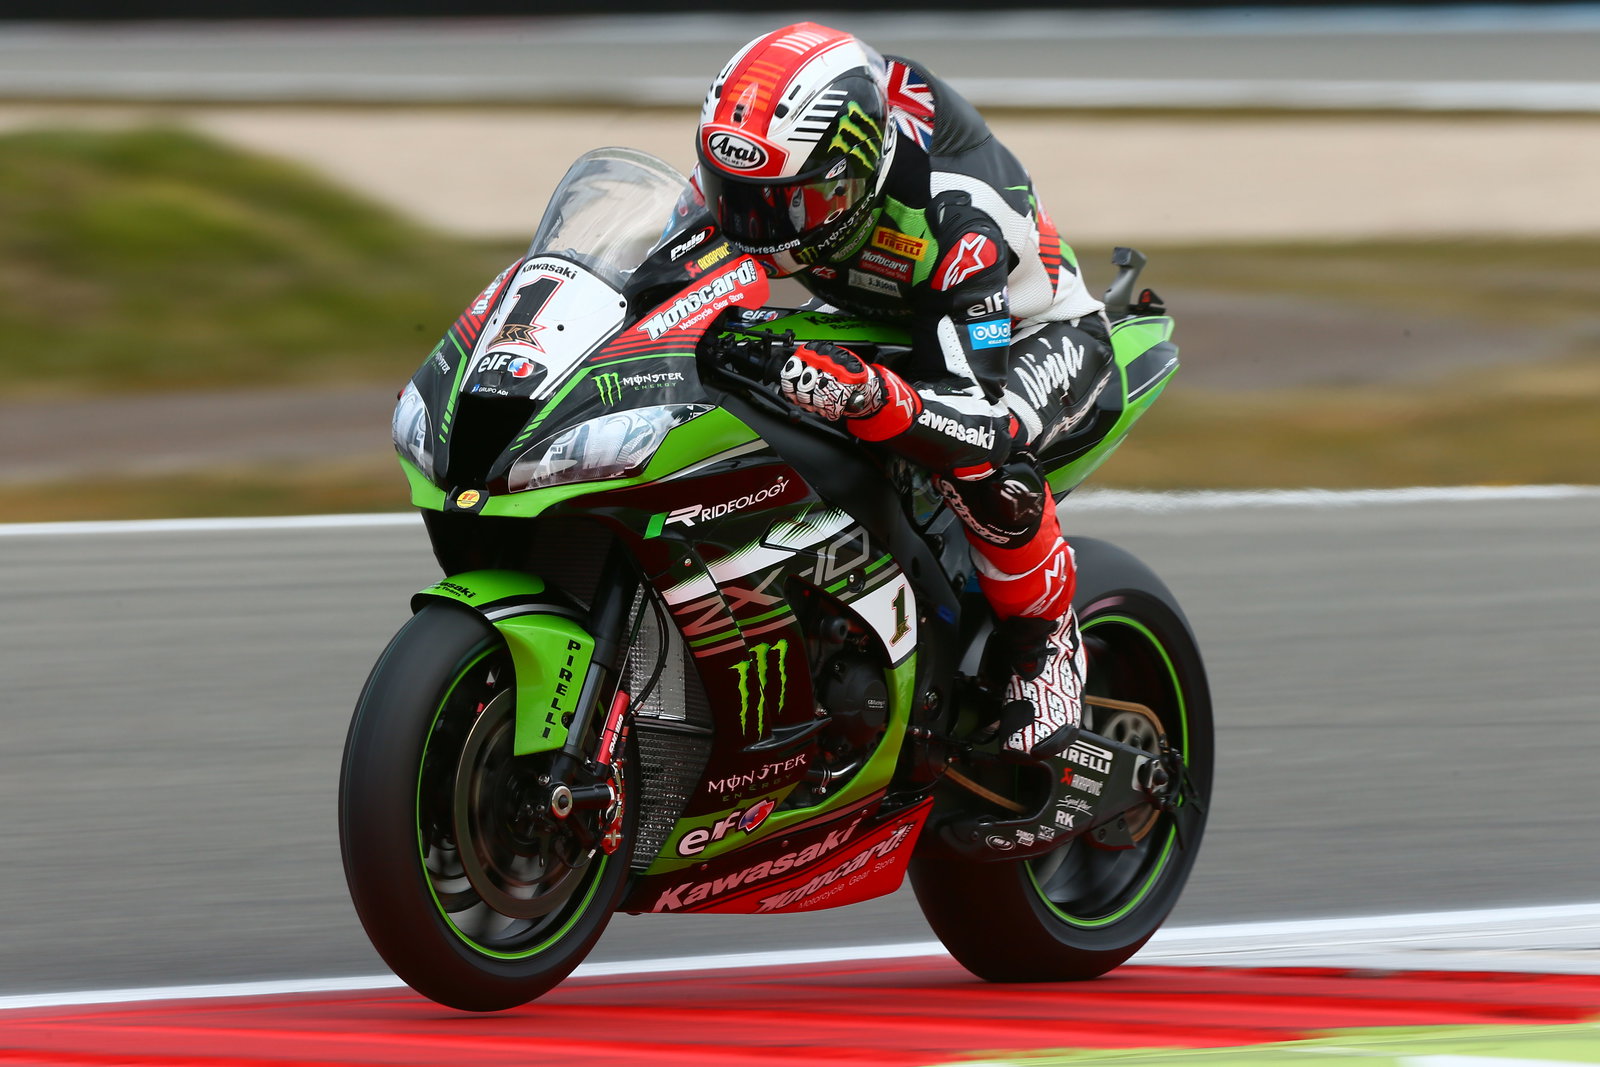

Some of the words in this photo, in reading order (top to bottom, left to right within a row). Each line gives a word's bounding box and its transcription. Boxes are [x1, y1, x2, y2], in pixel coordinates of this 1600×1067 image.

[711, 136, 758, 163] Arai
[670, 231, 705, 260] Puig
[877, 231, 923, 256] PIRELLI
[522, 263, 578, 280] Kawasaki
[678, 307, 713, 331] Motorcycle
[713, 299, 729, 311] Gear
[729, 293, 744, 304] Store
[742, 310, 767, 322] elf
[478, 354, 512, 373] elf
[1014, 336, 1085, 410] Ninja
[622, 371, 685, 386] MONSTER
[634, 382, 677, 391] ENERGY
[918, 408, 996, 450] awasaki
[701, 479, 789, 522] RIDEOLOGY
[891, 583, 911, 648] 1
[541, 639, 582, 739] PIRELLI
[708, 753, 806, 794] MONSTER
[722, 774, 792, 802] ENERGY
[1055, 810, 1075, 828] RK
[651, 817, 863, 913] Kawasaki
[798, 884, 846, 909] Motorcycle
[849, 870, 871, 887] Gear
[873, 856, 896, 873] Store
